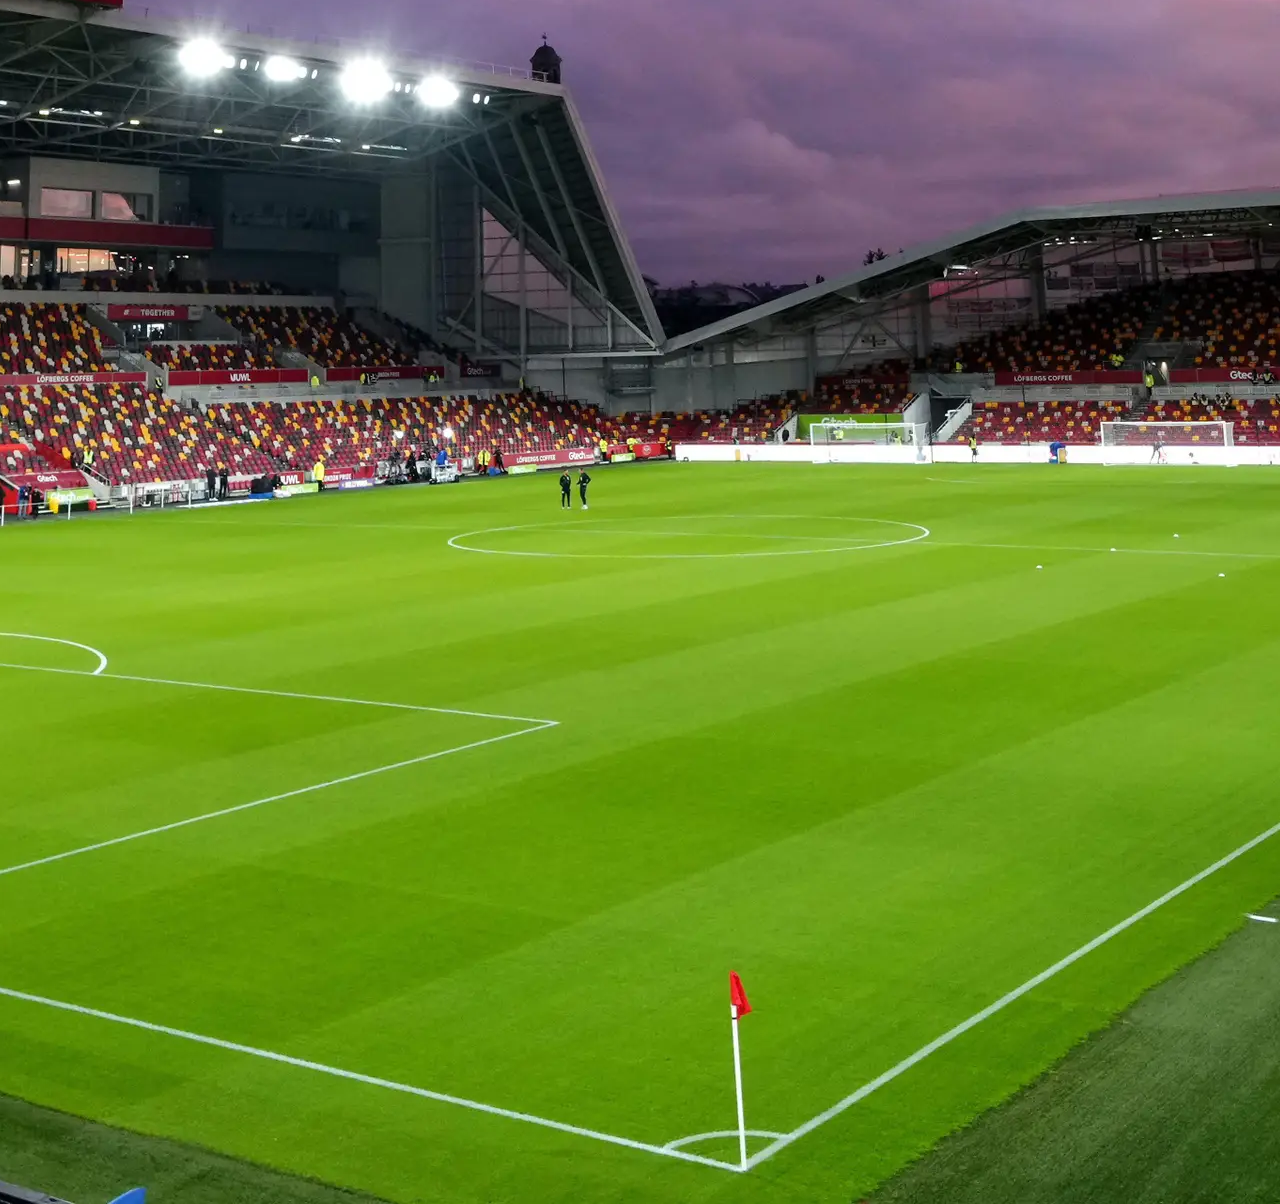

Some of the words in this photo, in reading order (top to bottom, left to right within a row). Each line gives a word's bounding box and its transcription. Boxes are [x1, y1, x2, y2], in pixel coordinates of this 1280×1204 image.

[36, 374, 69, 383] LÖFBERGS
[70, 374, 94, 382] COFFEE
[1013, 374, 1047, 382] LÖFBERGS
[1047, 374, 1073, 382] COFFEE
